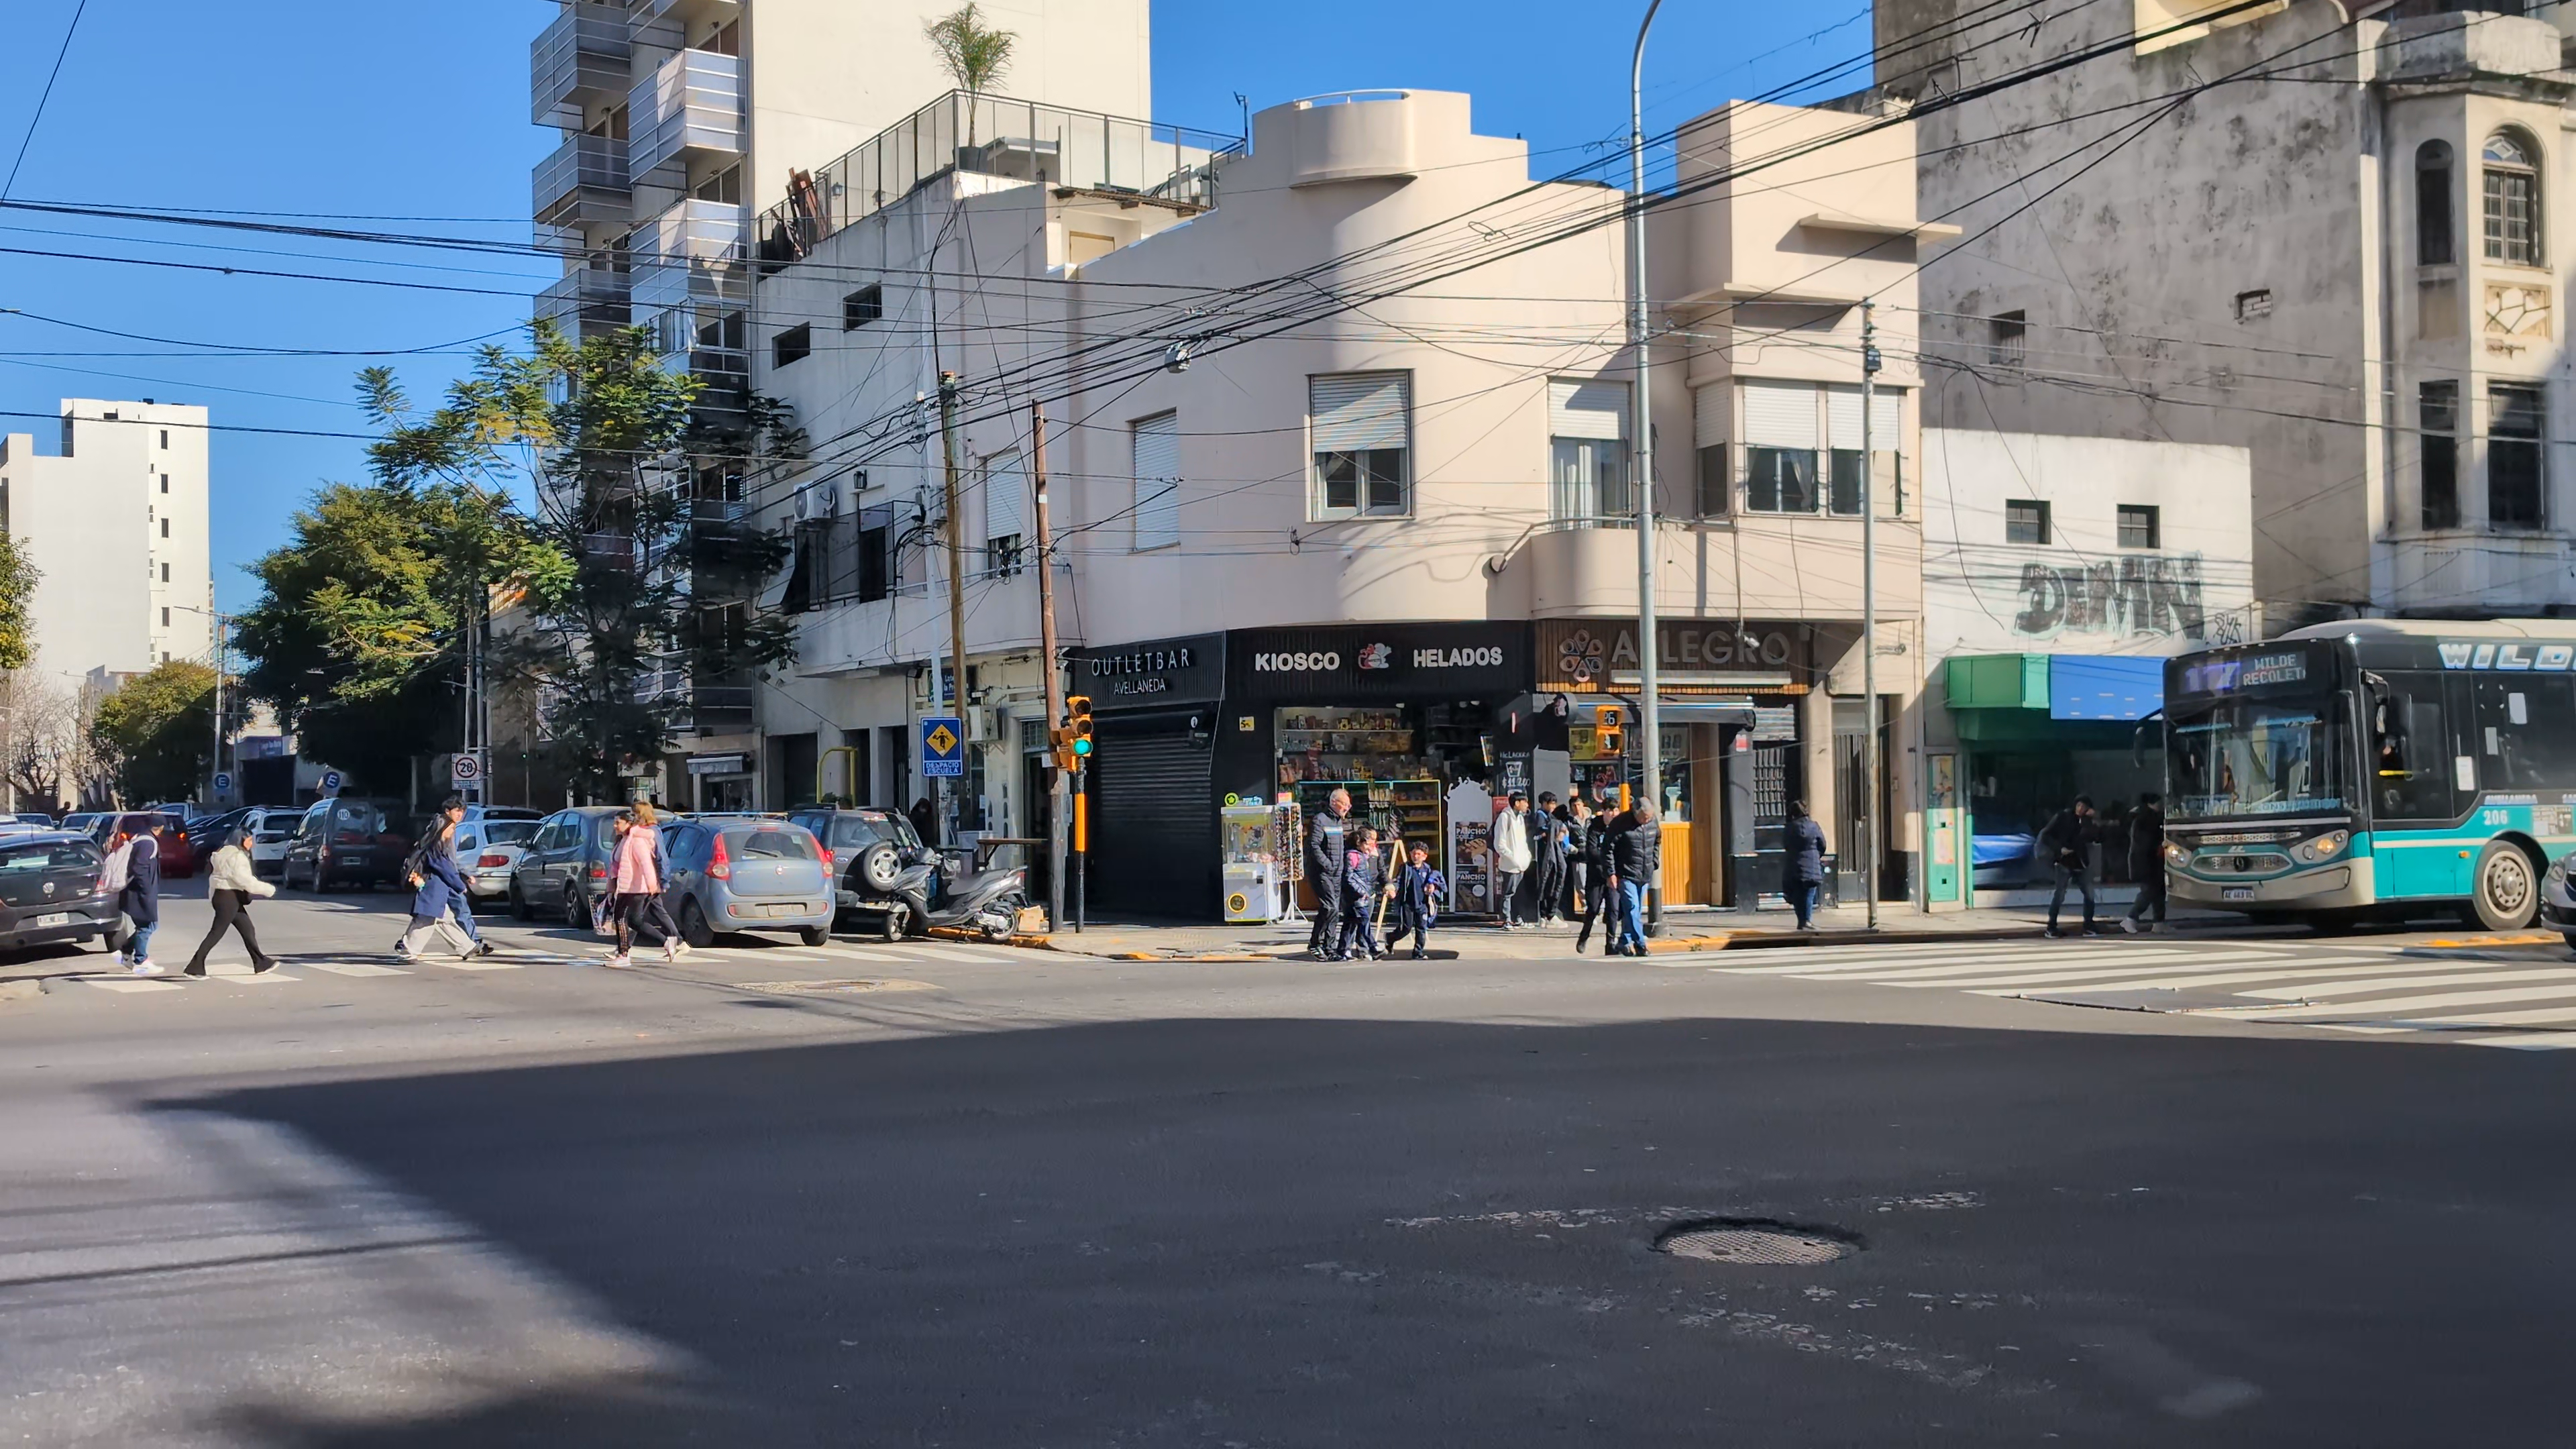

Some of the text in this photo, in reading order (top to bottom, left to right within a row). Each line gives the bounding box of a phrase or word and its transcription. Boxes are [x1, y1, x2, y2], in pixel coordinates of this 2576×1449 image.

[1611, 629, 1790, 665] ALEGRO
[1254, 651, 1340, 672] KIOSCO
[1413, 646, 1503, 668] HELADOS
[2255, 653, 2297, 671] WILDE
[2438, 643, 2576, 671] WILD
[1114, 678, 1166, 695] AVELLANEDA
[460, 762, 473, 773] 20
[218, 776, 227, 786] E
[327, 775, 337, 786] E
[339, 810, 349, 820] 110
[2483, 809, 2508, 826] 206
[1456, 827, 1487, 835] PANCHO
